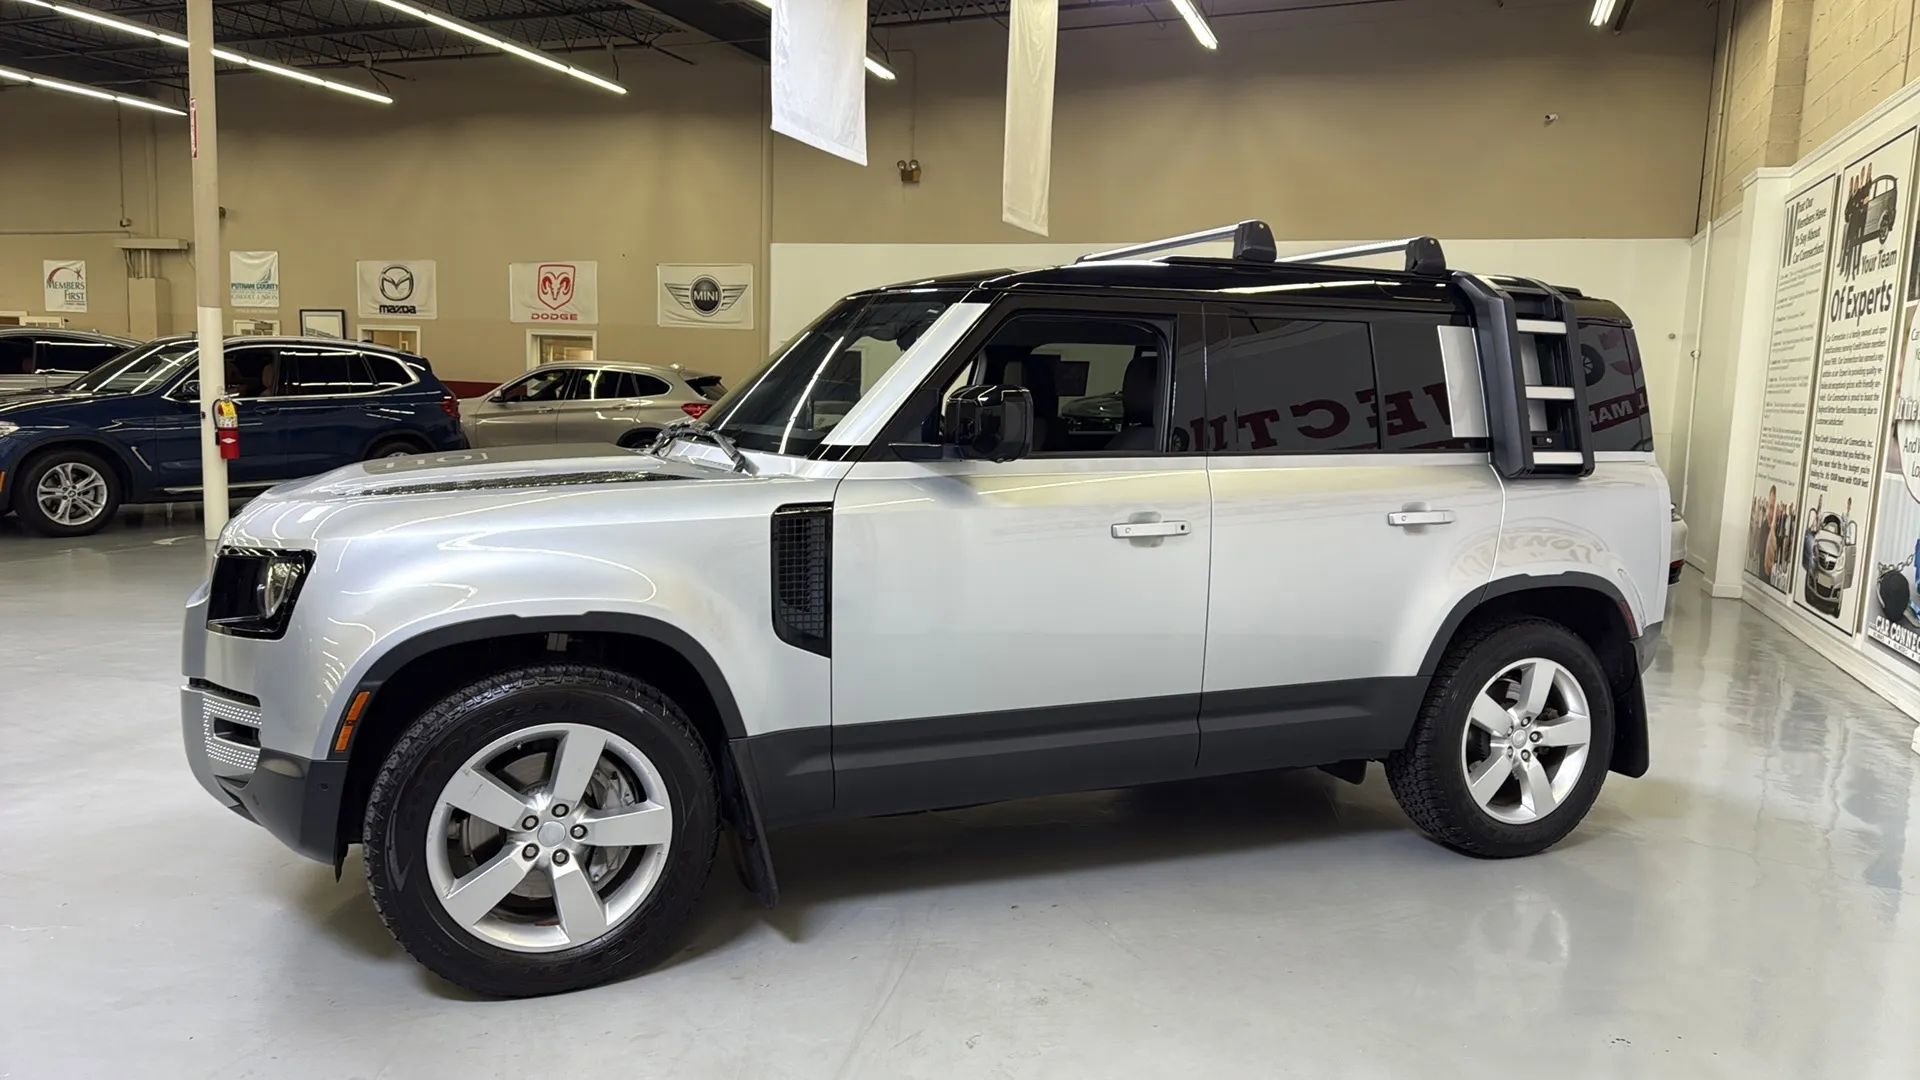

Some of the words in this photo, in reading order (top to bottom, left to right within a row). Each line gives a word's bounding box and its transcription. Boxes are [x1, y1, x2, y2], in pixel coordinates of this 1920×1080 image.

[1862, 254, 1877, 275] Your
[1878, 250, 1897, 270] Team
[47, 279, 85, 290] MEMBERS
[64, 289, 84, 300] FIRST
[693, 290, 718, 301] MINI
[379, 304, 416, 314] mazda
[1831, 285, 1846, 322] Of
[1845, 280, 1892, 327] Experts
[1876, 615, 1890, 637] CAR
